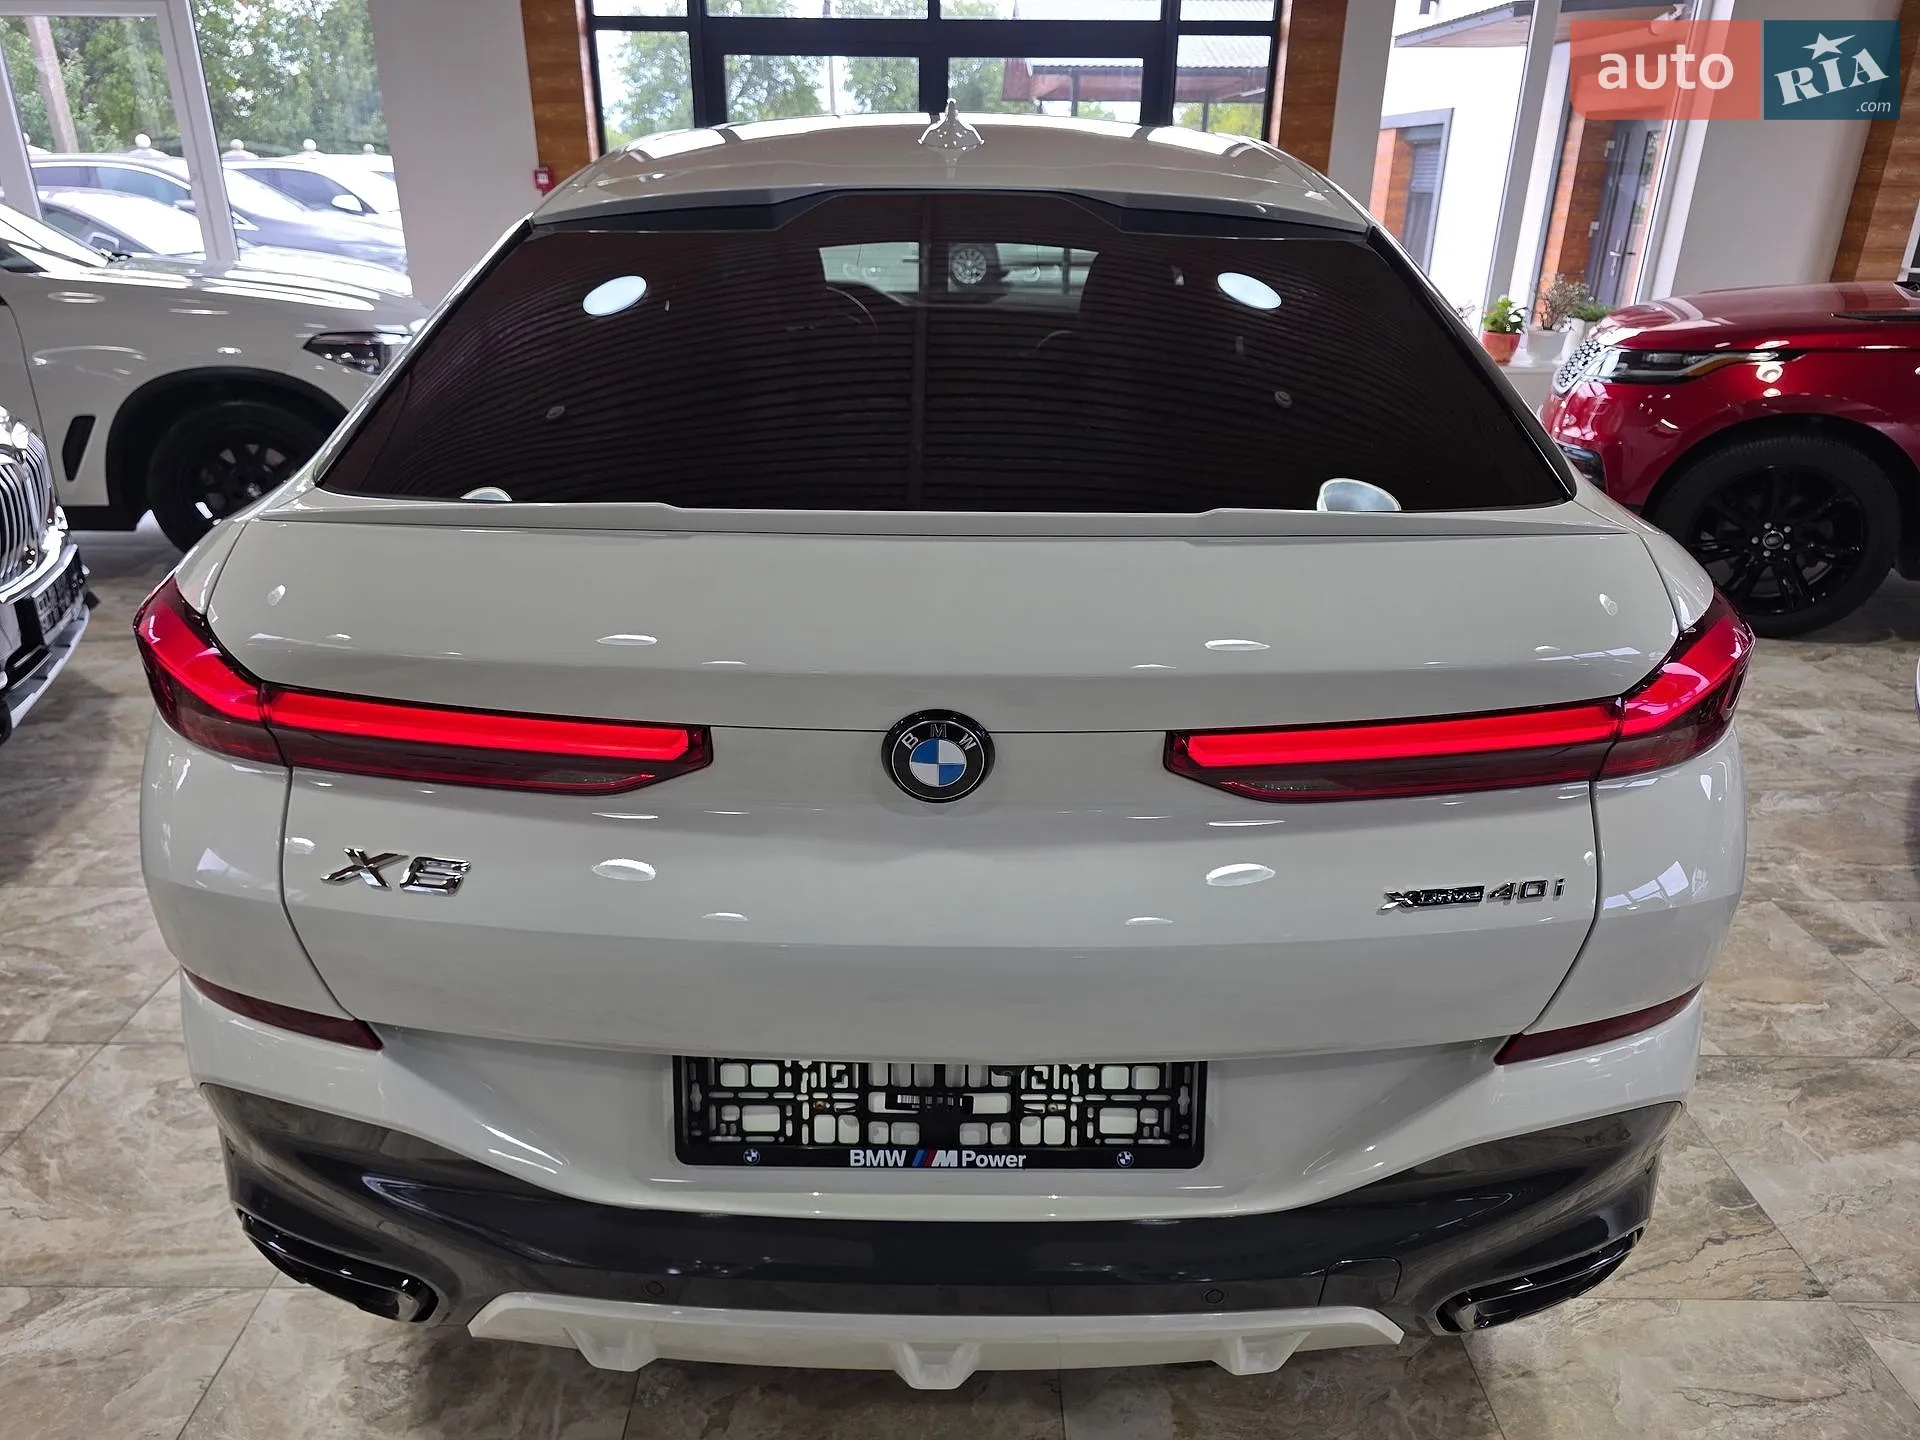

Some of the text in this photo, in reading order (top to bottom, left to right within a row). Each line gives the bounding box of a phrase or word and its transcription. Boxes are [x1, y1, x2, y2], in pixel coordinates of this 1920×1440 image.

[901, 723, 977, 750] BMW
[320, 847, 472, 896] X6
[850, 1150, 907, 1167] BMW
